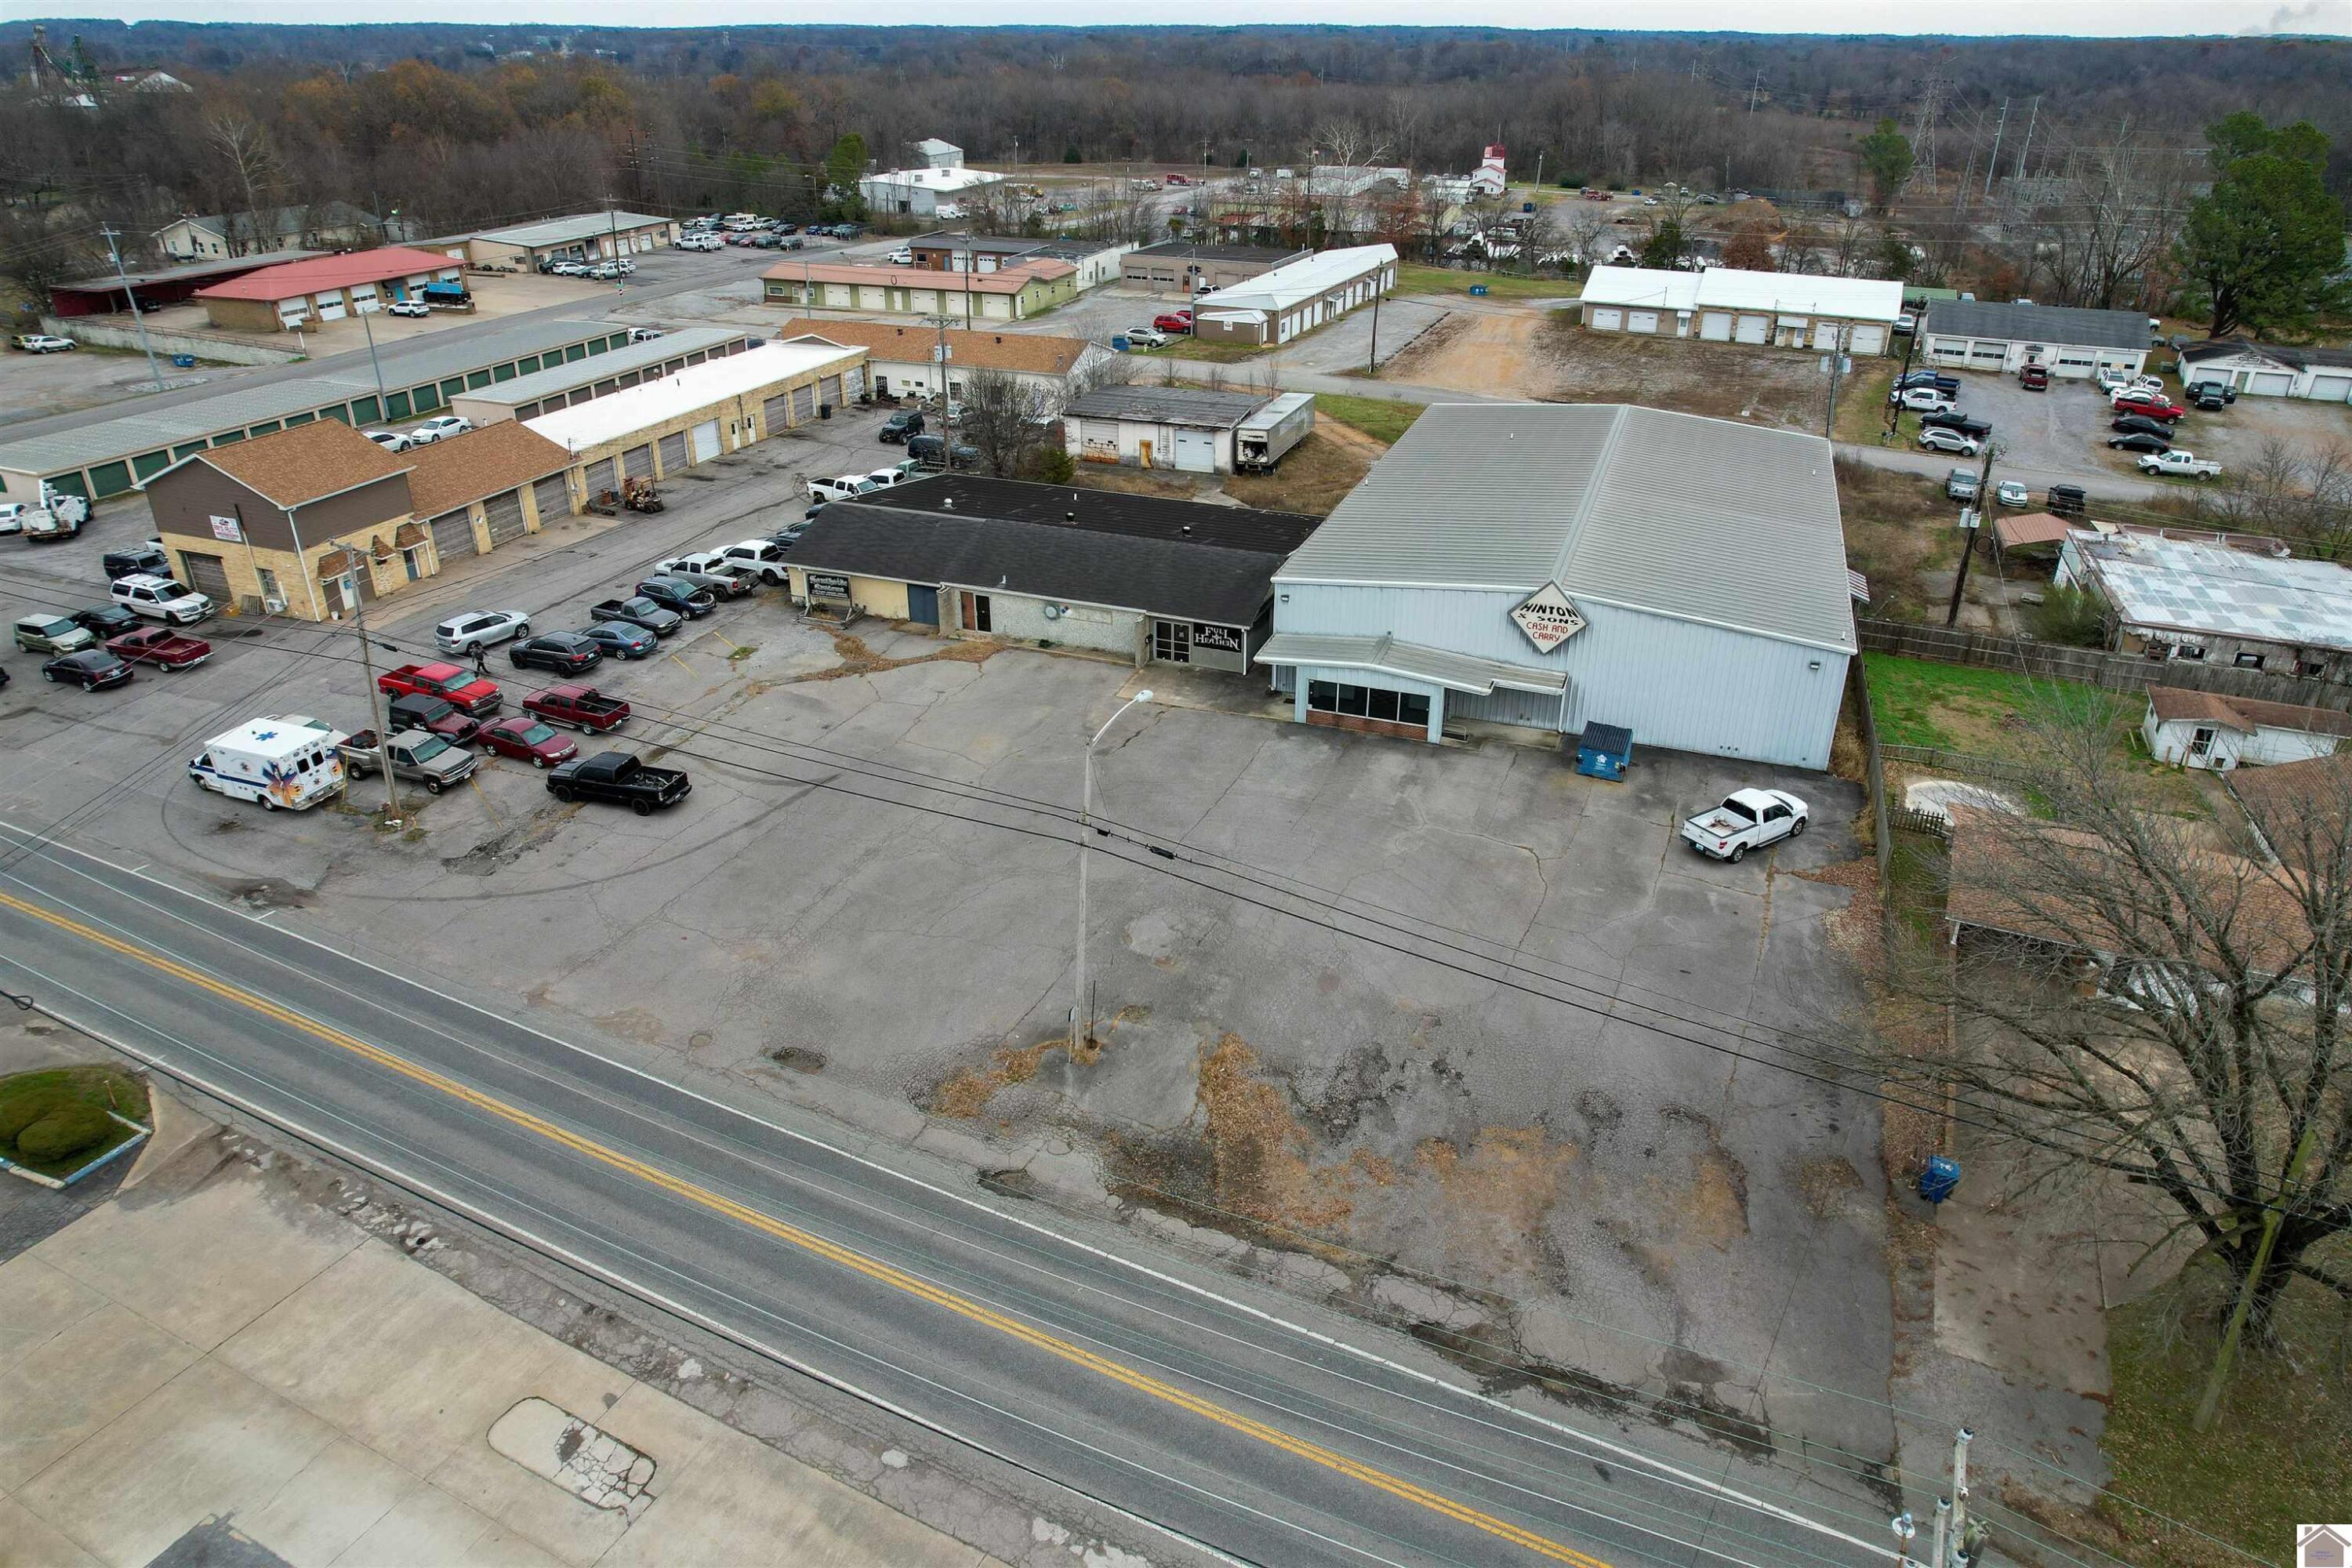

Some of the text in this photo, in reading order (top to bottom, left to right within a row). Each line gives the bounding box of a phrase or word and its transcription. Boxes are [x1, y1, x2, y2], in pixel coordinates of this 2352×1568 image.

[1519, 602, 1579, 619] HINTON
[1537, 615, 1580, 626] SONS
[1204, 626, 1229, 639] FULL
[1526, 621, 1569, 634] CASH AND
[1532, 631, 1560, 642] CARRY
